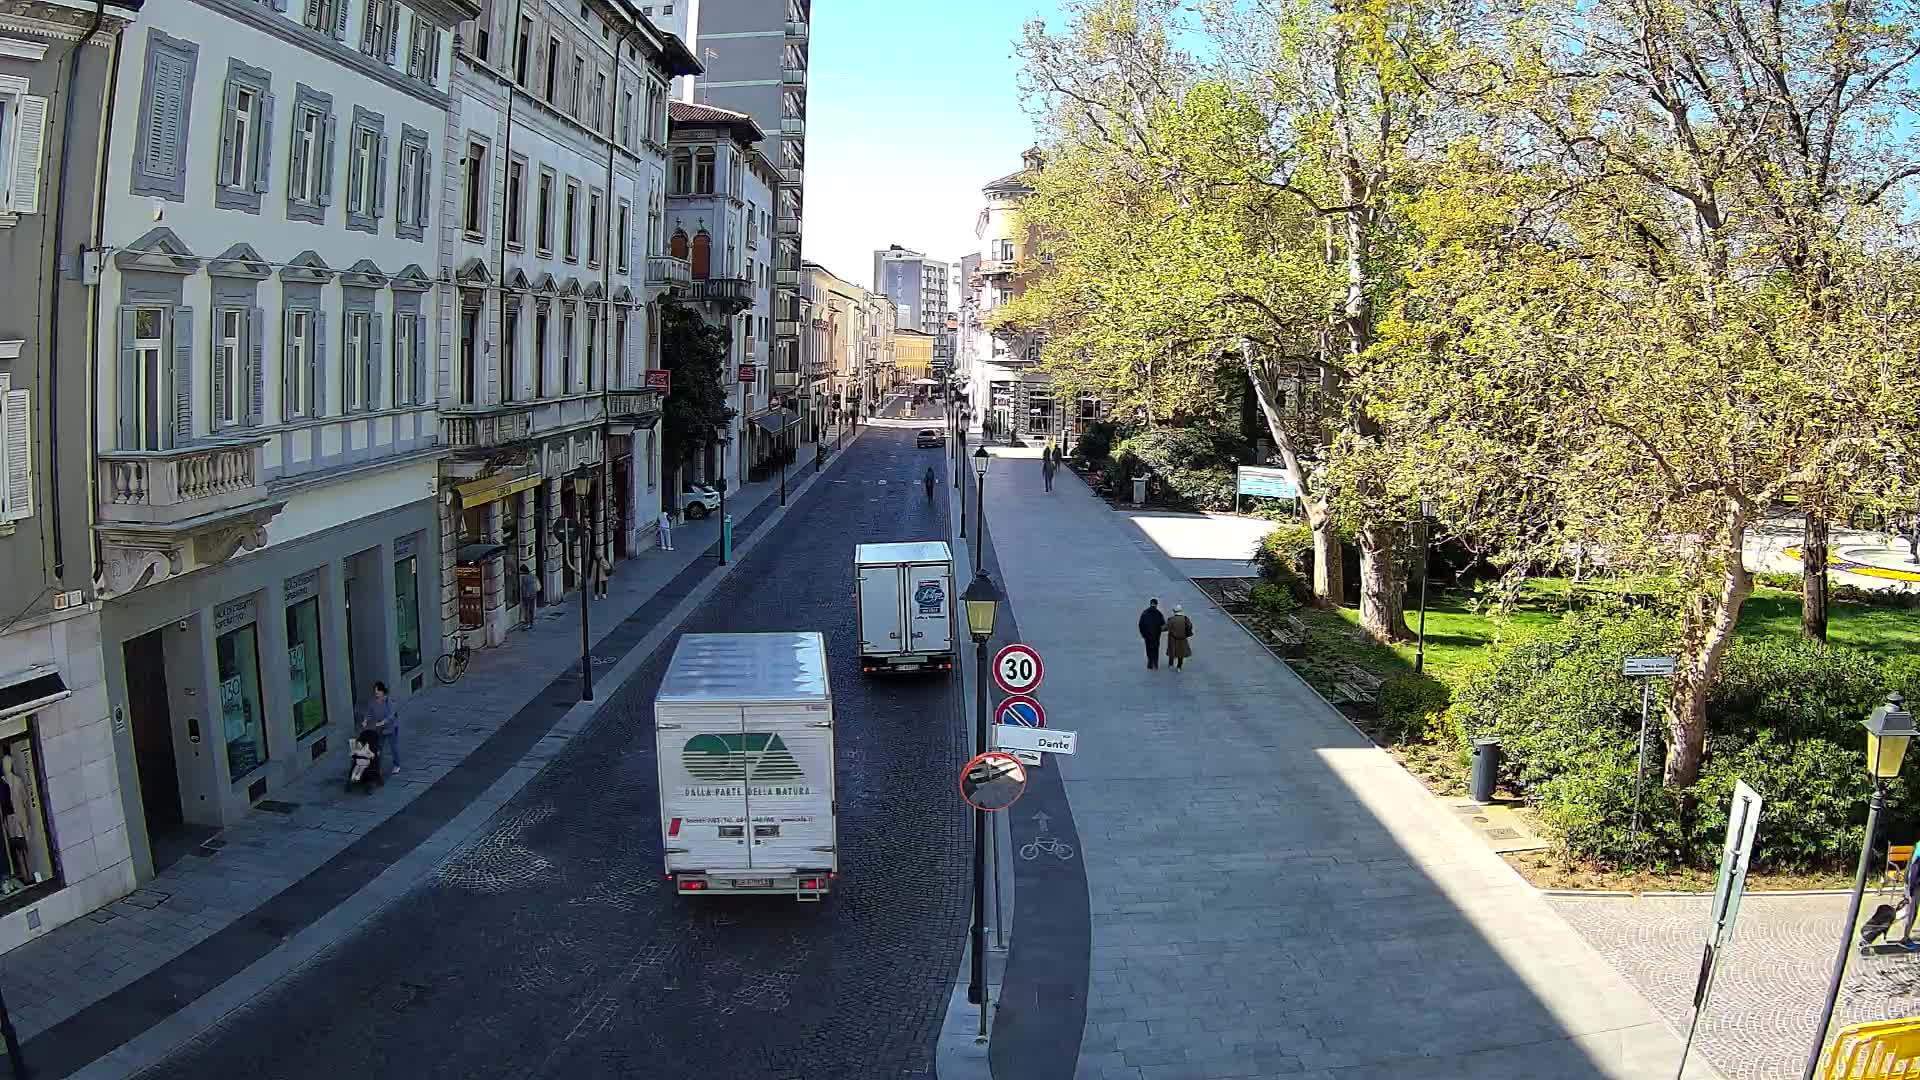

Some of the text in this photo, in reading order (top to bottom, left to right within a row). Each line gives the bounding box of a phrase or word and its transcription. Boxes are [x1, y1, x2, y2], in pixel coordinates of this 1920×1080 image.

[1005, 658, 1032, 680] 30
[1038, 738, 1069, 750] Dante
[685, 786, 810, 797] DALLA PARTE DELLA NATURA
